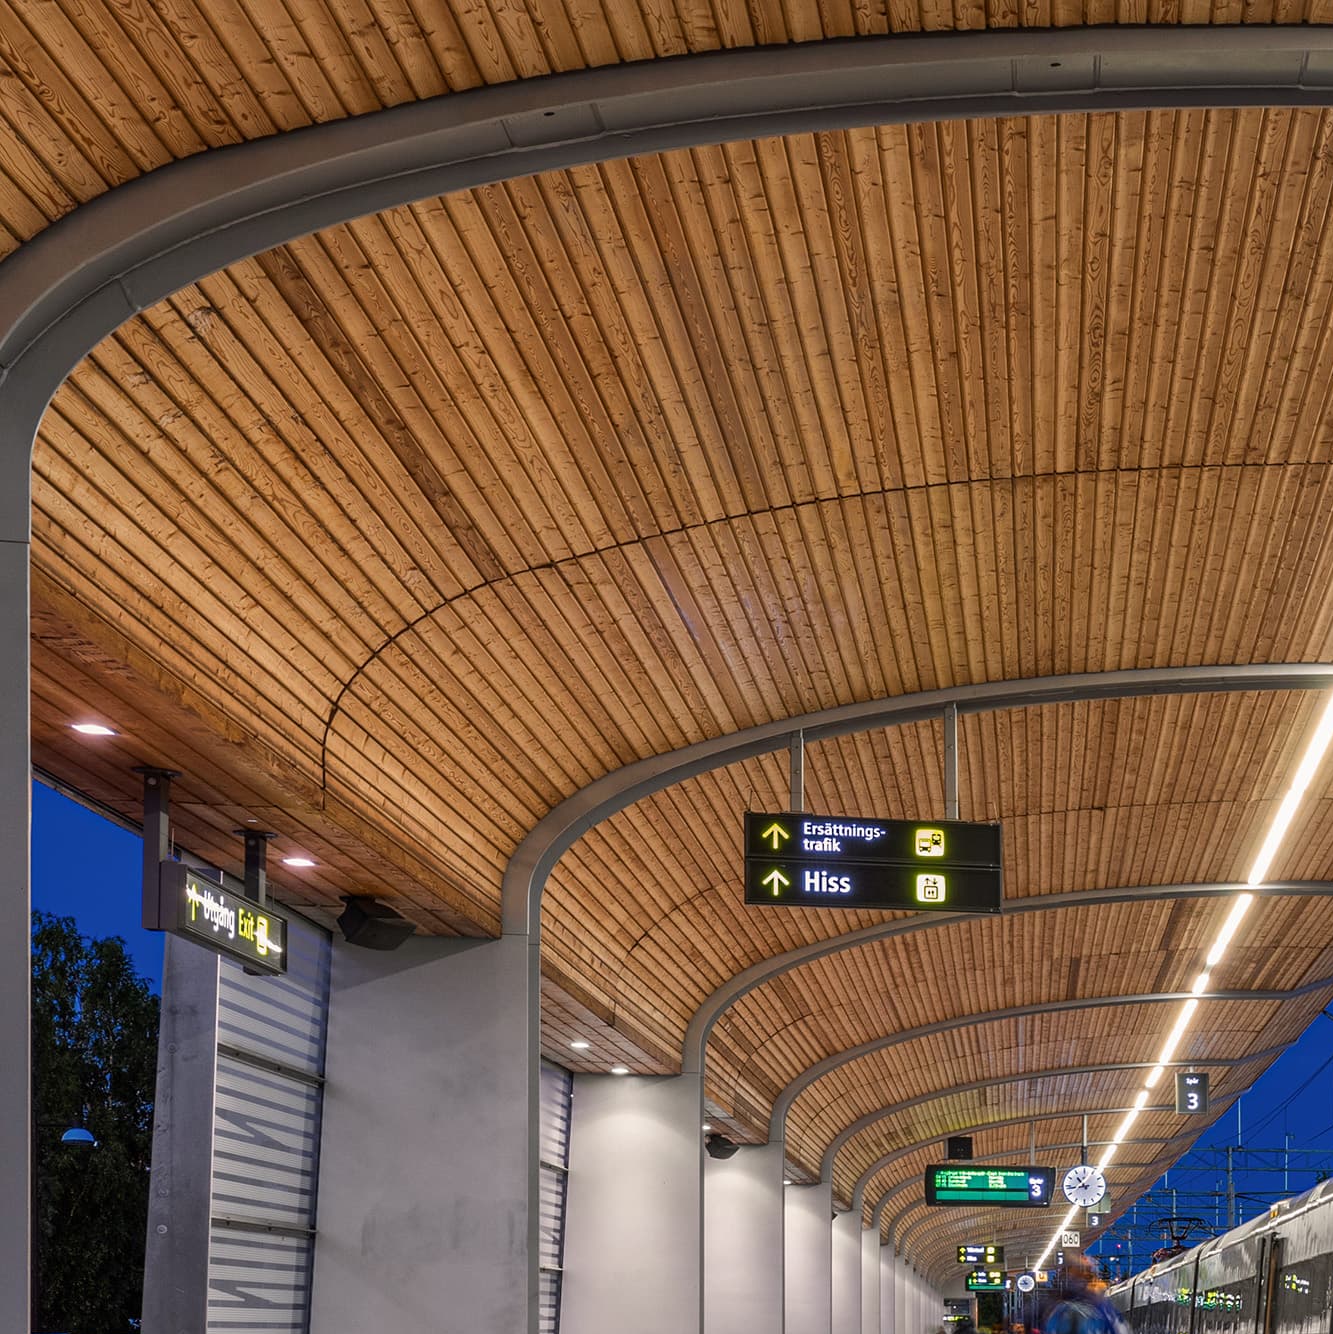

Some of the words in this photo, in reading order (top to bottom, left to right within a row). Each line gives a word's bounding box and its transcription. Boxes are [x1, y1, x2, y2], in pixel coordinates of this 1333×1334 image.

[803, 822, 886, 839] Ersättnings-
[803, 838, 841, 852] trafik
[804, 870, 851, 893] Hiss
[238, 908, 254, 942] Exit
[1187, 1092, 1199, 1110] 3
[1031, 1184, 1042, 1197] 3
[1091, 1215, 1100, 1227] 3
[1063, 1233, 1079, 1245] 060
